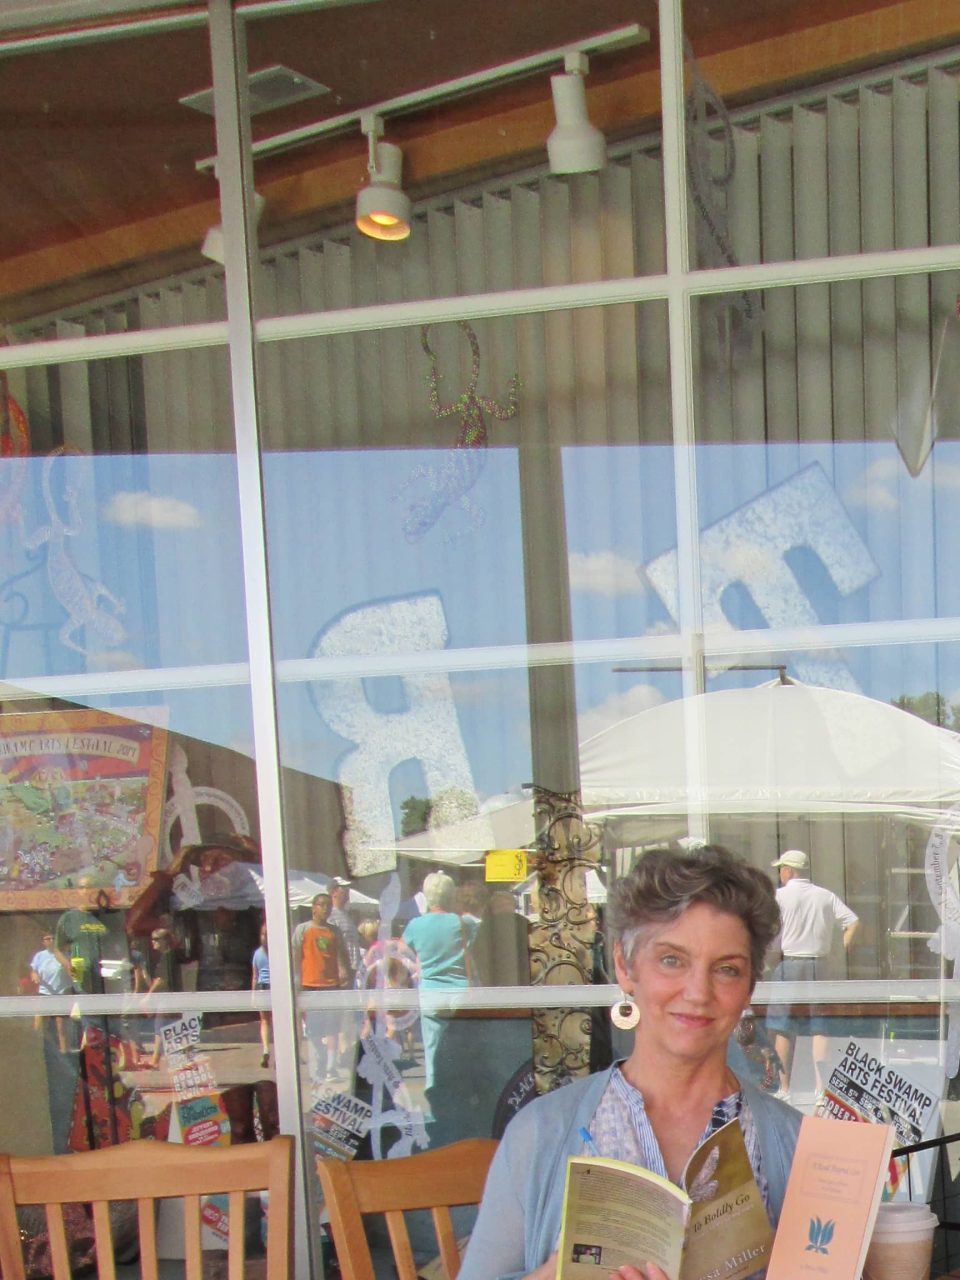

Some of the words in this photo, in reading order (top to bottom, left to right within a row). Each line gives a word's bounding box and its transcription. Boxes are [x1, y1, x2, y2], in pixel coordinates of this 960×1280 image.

[838, 1056, 870, 1086] ARTS
[870, 1079, 922, 1125] FESTIVAL
[845, 1041, 886, 1078] BLACK
[885, 1070, 932, 1110] SWAMP
[314, 1100, 363, 1134] ESTIVAL
[735, 1193, 751, 1206] Go
[724, 1243, 767, 1272] Miller
